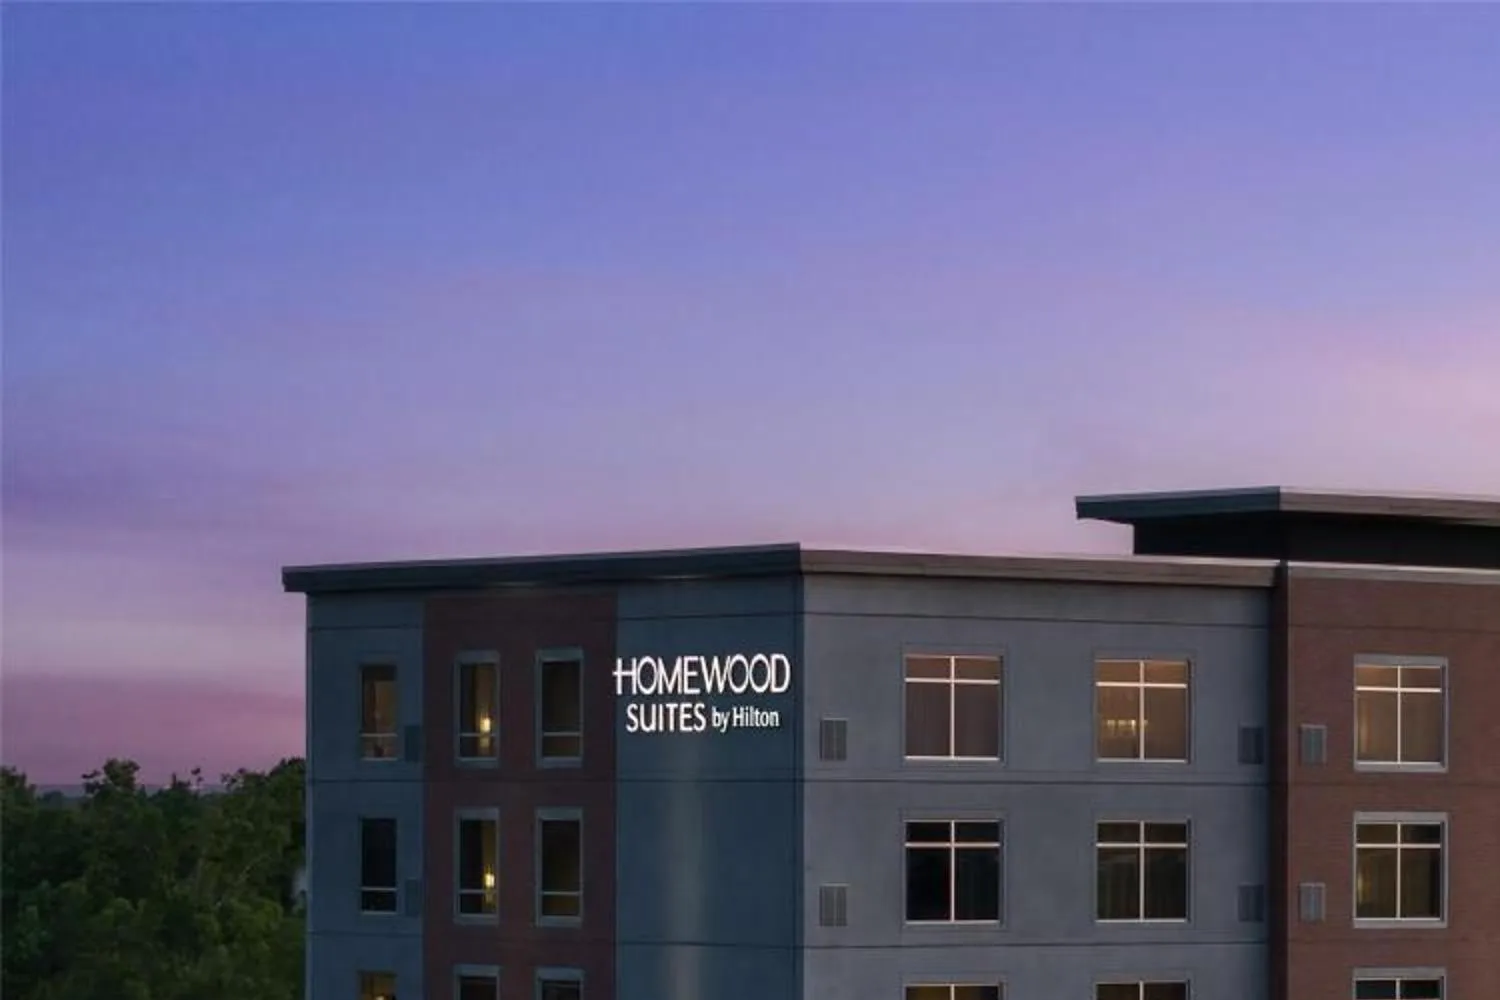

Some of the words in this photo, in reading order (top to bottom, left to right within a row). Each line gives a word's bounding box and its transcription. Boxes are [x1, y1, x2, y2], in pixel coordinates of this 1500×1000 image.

[612, 653, 791, 695] HOMEWOOD
[626, 702, 706, 732] SUITES
[712, 706, 730, 733] by
[732, 706, 780, 727] Hilton
